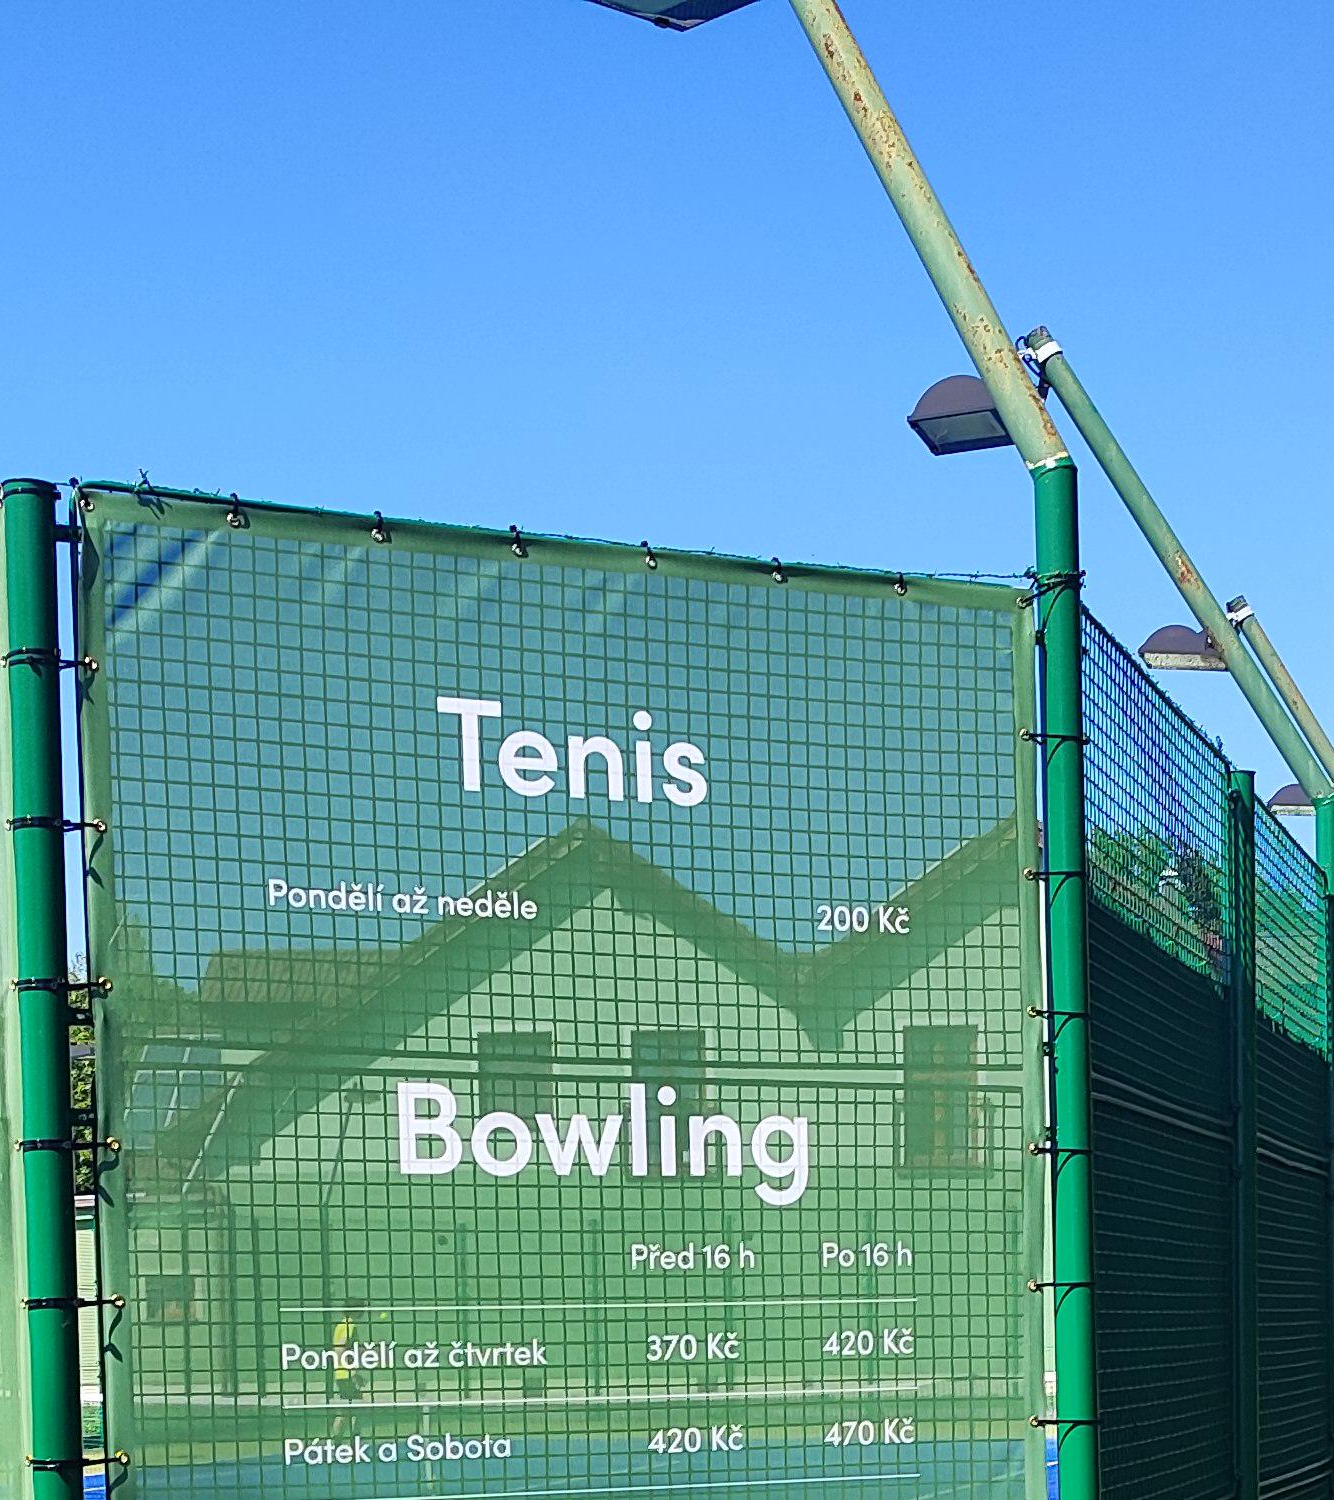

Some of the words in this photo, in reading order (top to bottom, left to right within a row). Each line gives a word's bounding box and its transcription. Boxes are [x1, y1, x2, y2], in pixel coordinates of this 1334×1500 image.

[436, 696, 708, 808] Tenis
[268, 878, 384, 913] Pondělí
[391, 885, 429, 916] až
[437, 889, 538, 921] neděle
[816, 904, 869, 932] 200
[879, 906, 910, 935] Kč
[396, 1080, 810, 1206] Bowling
[630, 1243, 697, 1271] Před
[702, 1245, 729, 1270] 16
[739, 1244, 755, 1269] h
[821, 1242, 855, 1268] Po
[862, 1243, 889, 1268] 16
[894, 1242, 913, 1266] h
[281, 1341, 398, 1371] Pondělí
[404, 1339, 440, 1369] až
[448, 1339, 547, 1367] čtvrtek
[646, 1334, 698, 1362] 370
[706, 1332, 739, 1360] Kč
[822, 1330, 875, 1357] 420
[882, 1328, 914, 1356] Kč
[648, 1428, 703, 1455] 420
[711, 1424, 743, 1452] Kč
[823, 1420, 876, 1448] 470
[883, 1418, 915, 1444] Kč
[283, 1436, 371, 1466] Pátek
[377, 1441, 398, 1462] a
[406, 1434, 511, 1461] Sobota
